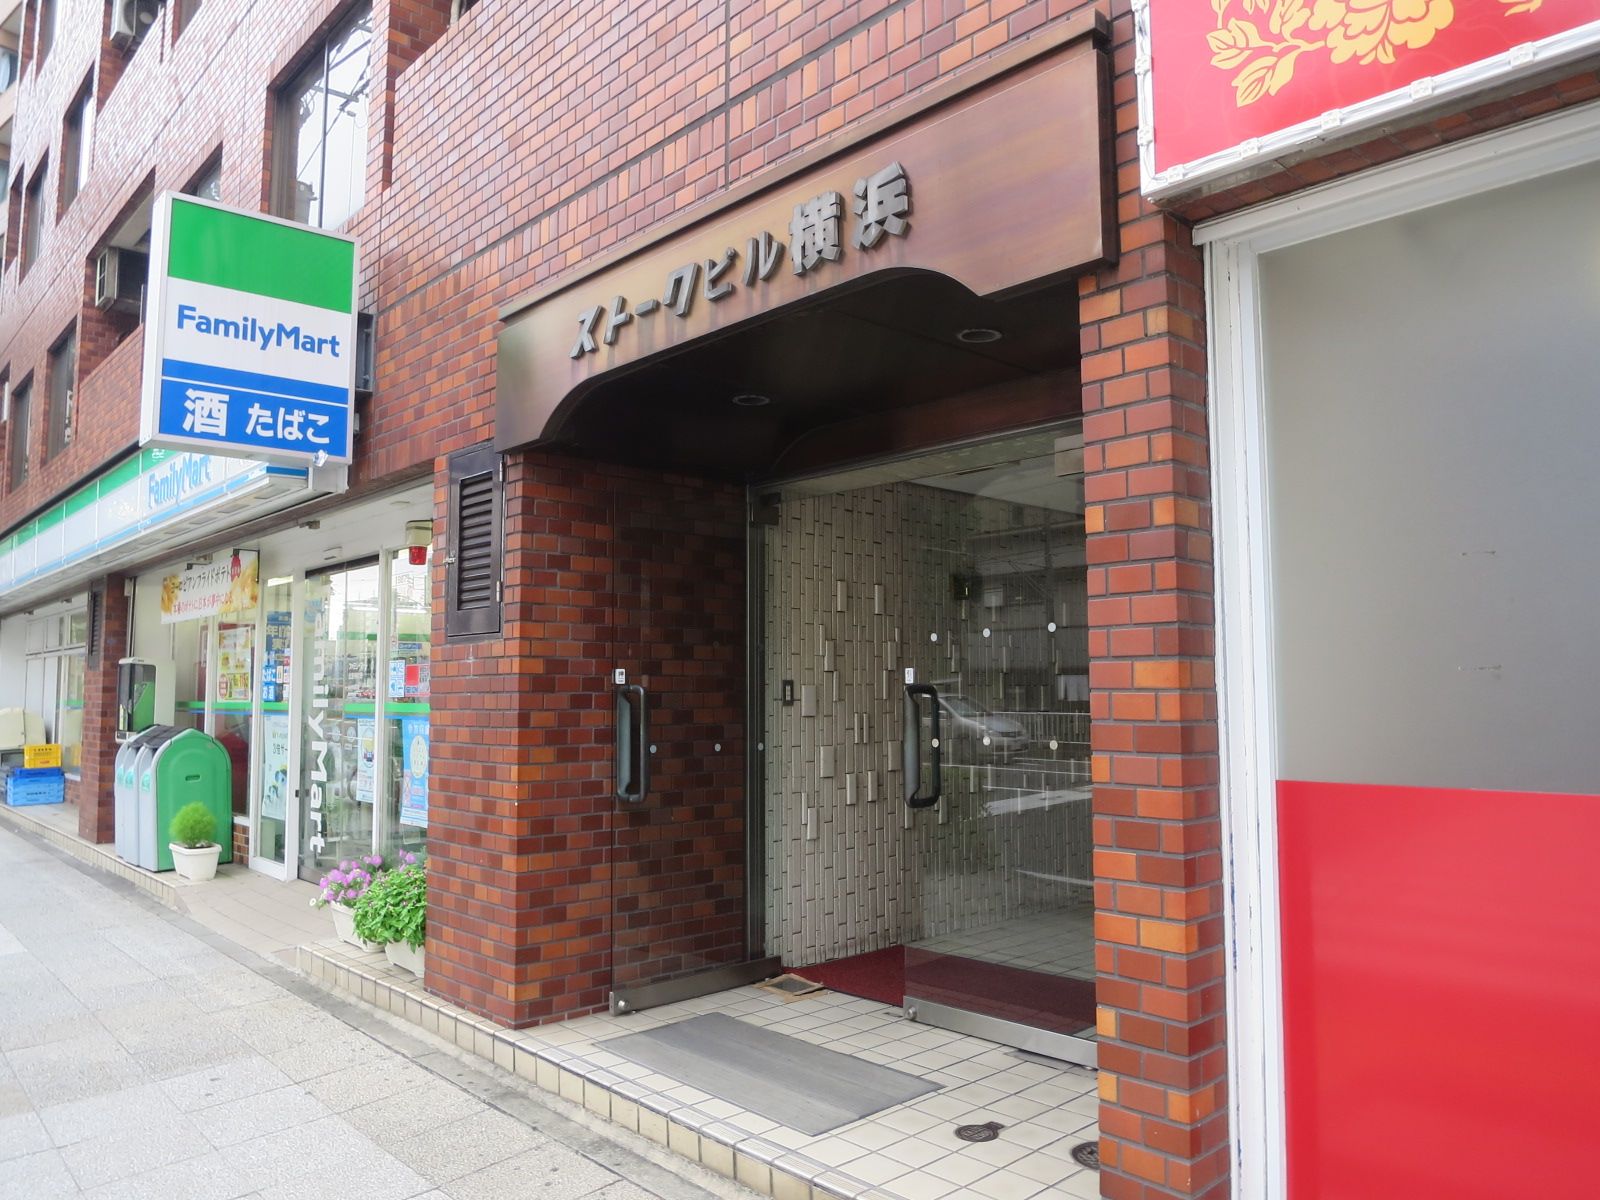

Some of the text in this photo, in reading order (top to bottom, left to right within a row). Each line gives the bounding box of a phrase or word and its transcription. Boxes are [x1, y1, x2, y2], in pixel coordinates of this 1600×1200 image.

[569, 161, 911, 359] ストークビル横浜
[177, 304, 340, 357] FamilyMart
[182, 388, 330, 444] 酒 たばこ
[149, 452, 211, 508] FamilyMart
[308, 612, 329, 854] amilyMart
